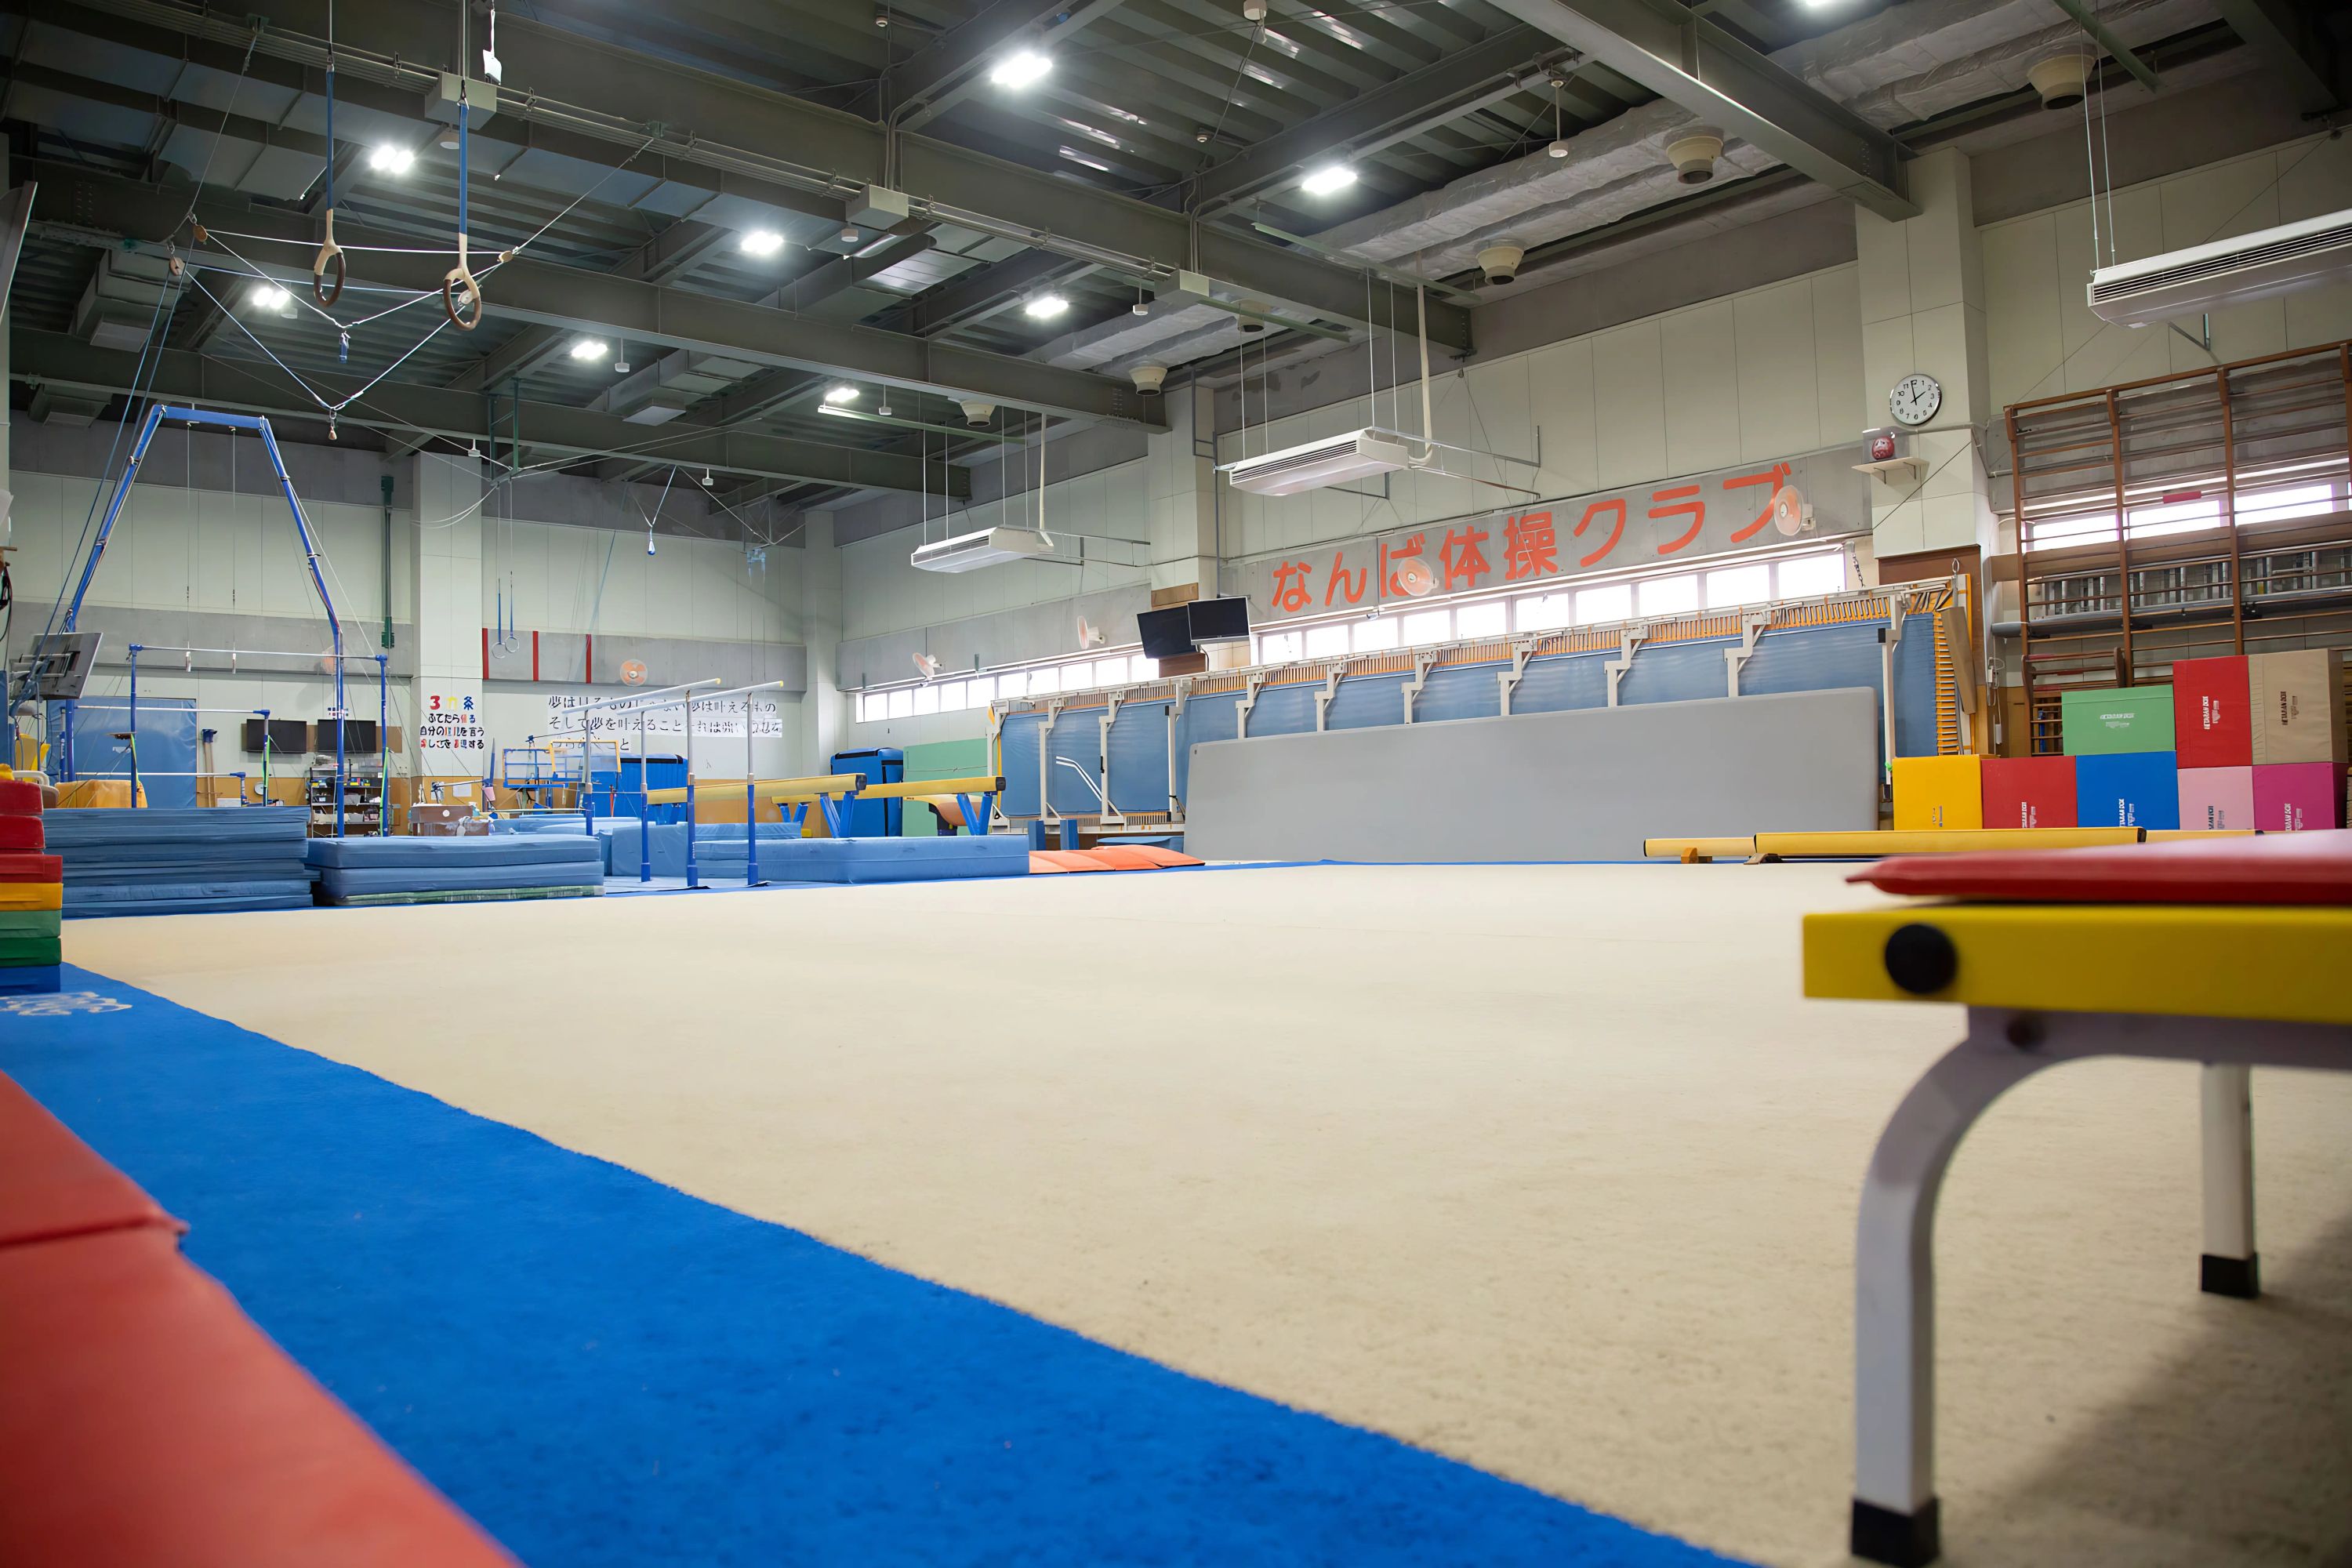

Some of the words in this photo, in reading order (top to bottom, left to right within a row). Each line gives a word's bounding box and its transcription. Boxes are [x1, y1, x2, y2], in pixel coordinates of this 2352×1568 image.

[1272, 462, 1791, 613] なんば体操クラブ
